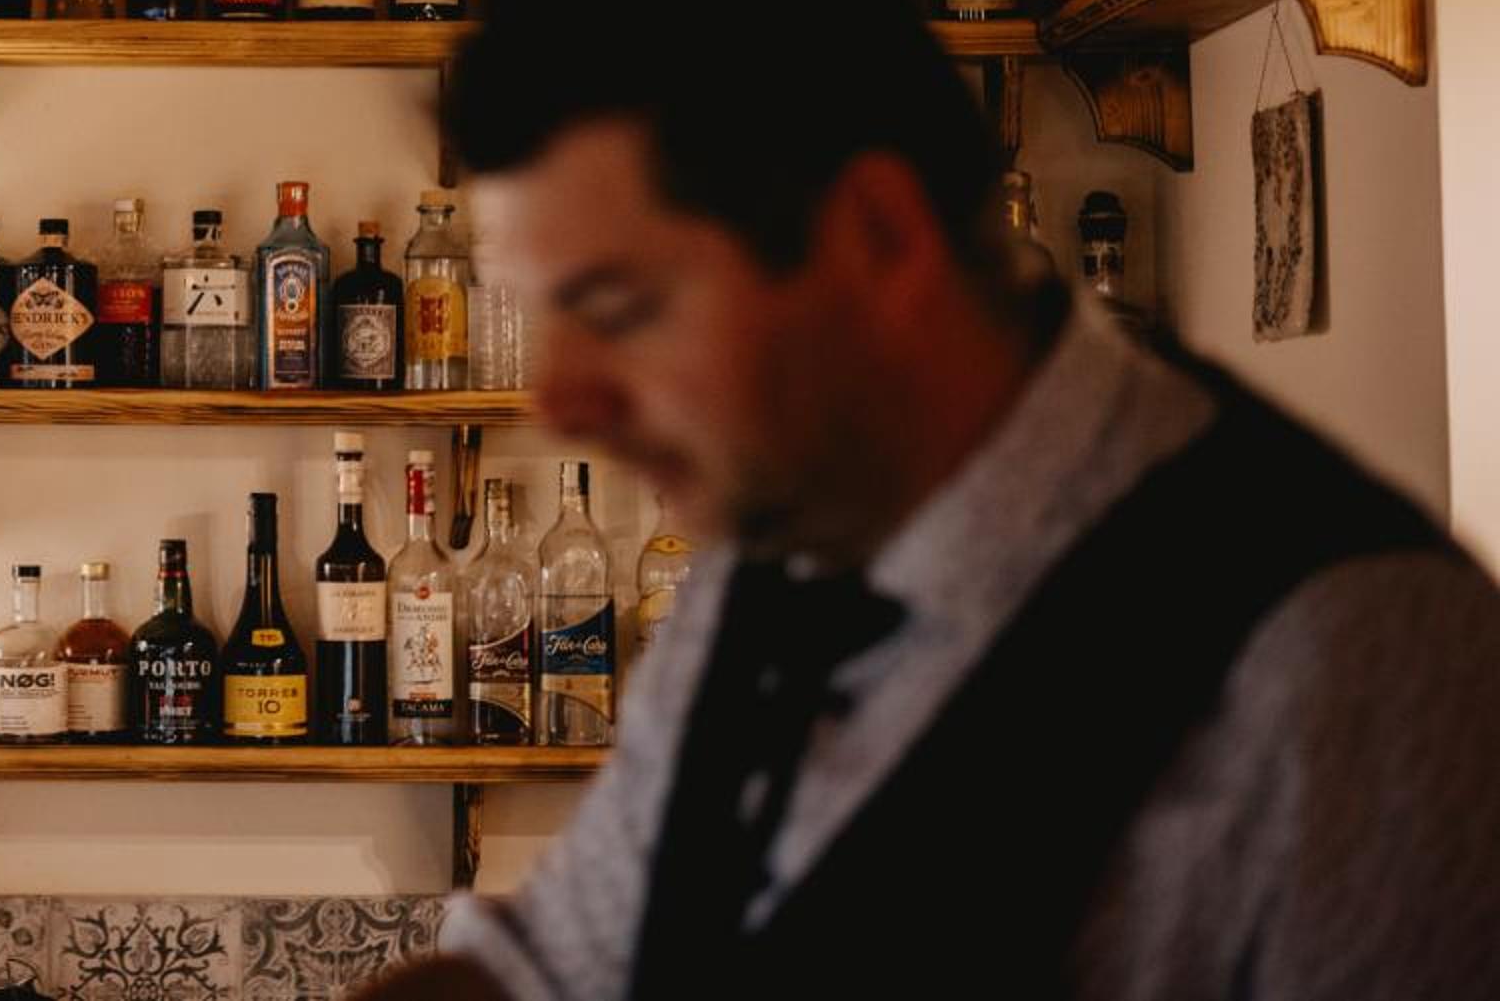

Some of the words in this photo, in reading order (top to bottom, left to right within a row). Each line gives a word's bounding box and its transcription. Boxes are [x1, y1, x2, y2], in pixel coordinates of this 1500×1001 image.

[139, 660, 211, 677] PORTO
[0, 673, 55, 688] NØG!
[257, 700, 281, 714] 10
